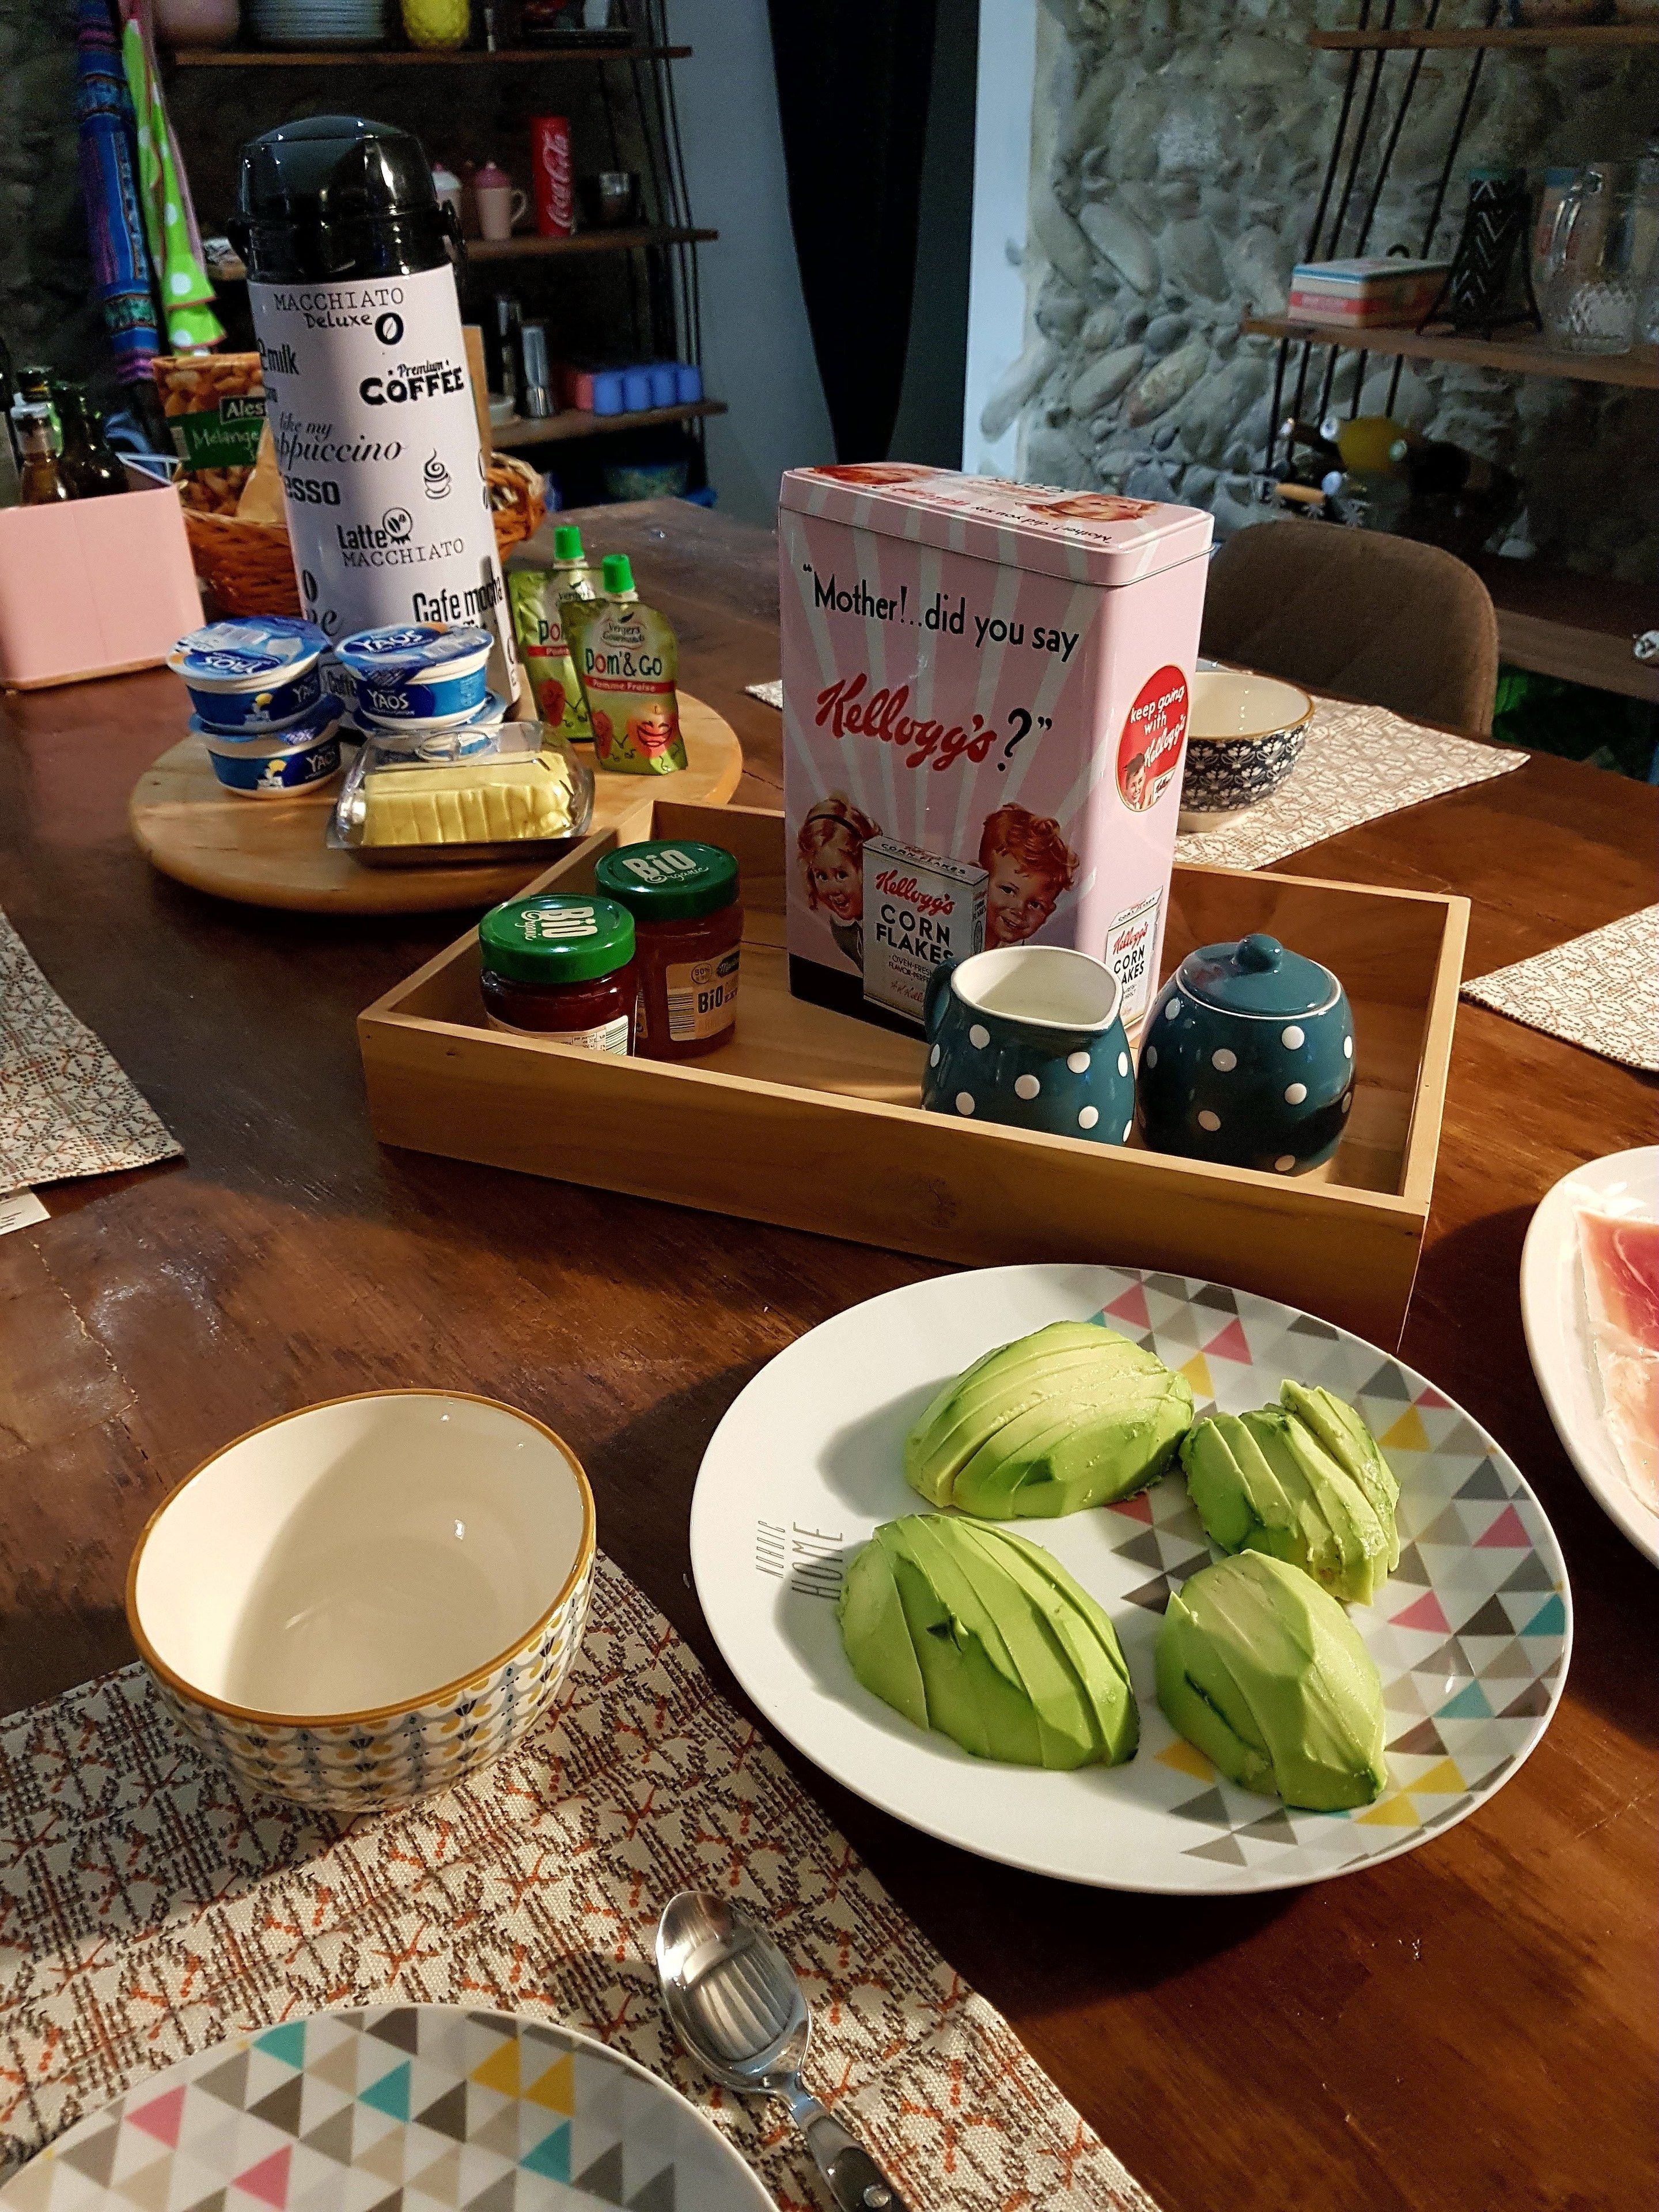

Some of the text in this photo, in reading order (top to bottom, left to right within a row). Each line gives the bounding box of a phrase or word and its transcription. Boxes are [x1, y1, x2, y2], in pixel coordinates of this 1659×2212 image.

[273, 287, 404, 312] MACCHIATO
[304, 313, 373, 329] Deluxe
[397, 361, 444, 378] Premium
[359, 367, 464, 406] COFFEE
[227, 399, 264, 419] Ales
[306, 423, 332, 442] my
[278, 432, 402, 471] ppuccino
[284, 475, 340, 506] esso
[342, 538, 464, 567] MACCHIATO
[412, 589, 461, 623] Cafe
[350, 630, 423, 652] YAOS
[974, 615, 1024, 649] you
[1033, 626, 1079, 662] say
[367, 689, 410, 710] YAOS
[1130, 684, 1186, 724] keep going
[1143, 711, 1168, 736] with
[1144, 714, 1187, 768] Kellogg's
[646, 866, 709, 884] Organic
[875, 869, 956, 916] Kellogg's
[880, 904, 950, 948] CORN
[876, 922, 955, 965] FLAKES
[1113, 944, 1146, 975] CORN
[1121, 960, 1145, 984] AKES
[755, 1520, 786, 1579] NORDIC
[791, 1521, 843, 1603] HOME
